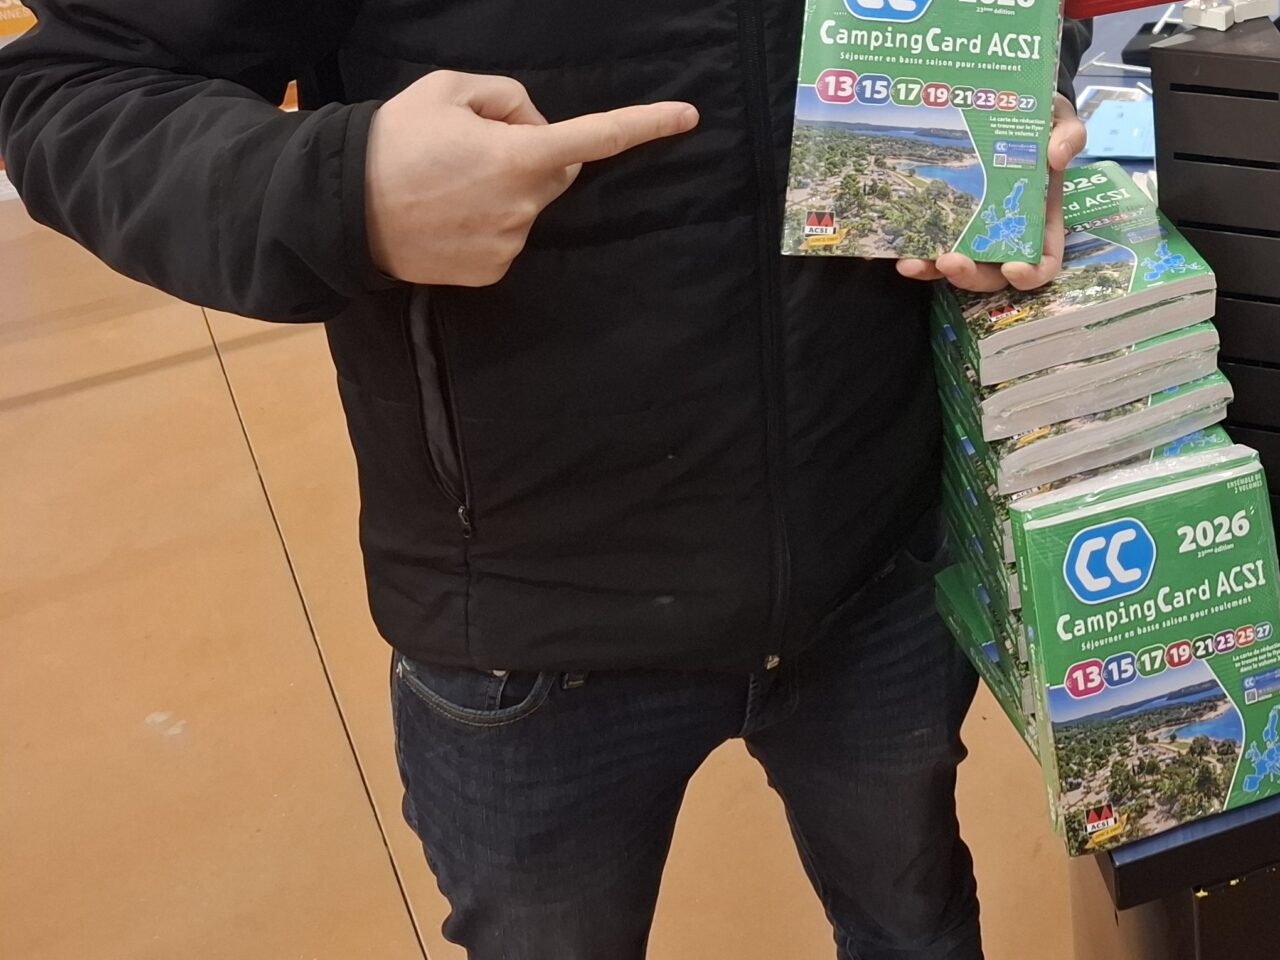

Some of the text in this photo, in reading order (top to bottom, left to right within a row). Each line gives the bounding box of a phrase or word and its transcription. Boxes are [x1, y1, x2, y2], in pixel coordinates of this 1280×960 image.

[820, 19, 1041, 59] CampingCard ACSI
[840, 51, 883, 63] Séjourner
[900, 56, 923, 65] basse
[926, 57, 953, 67] saison
[955, 61, 975, 70] pour
[977, 60, 1021, 71] seulement
[824, 76, 1034, 108] 13 15 17 19 21 23 25 27
[1063, 174, 1107, 192] 026
[1085, 188, 1131, 207] ACSI
[1177, 509, 1250, 554] 2026
[1075, 528, 1141, 592] CC
[1056, 559, 1266, 641] CampingCard ACSI
[1071, 624, 1270, 691] 13 15 17 19 21 23 25 27
